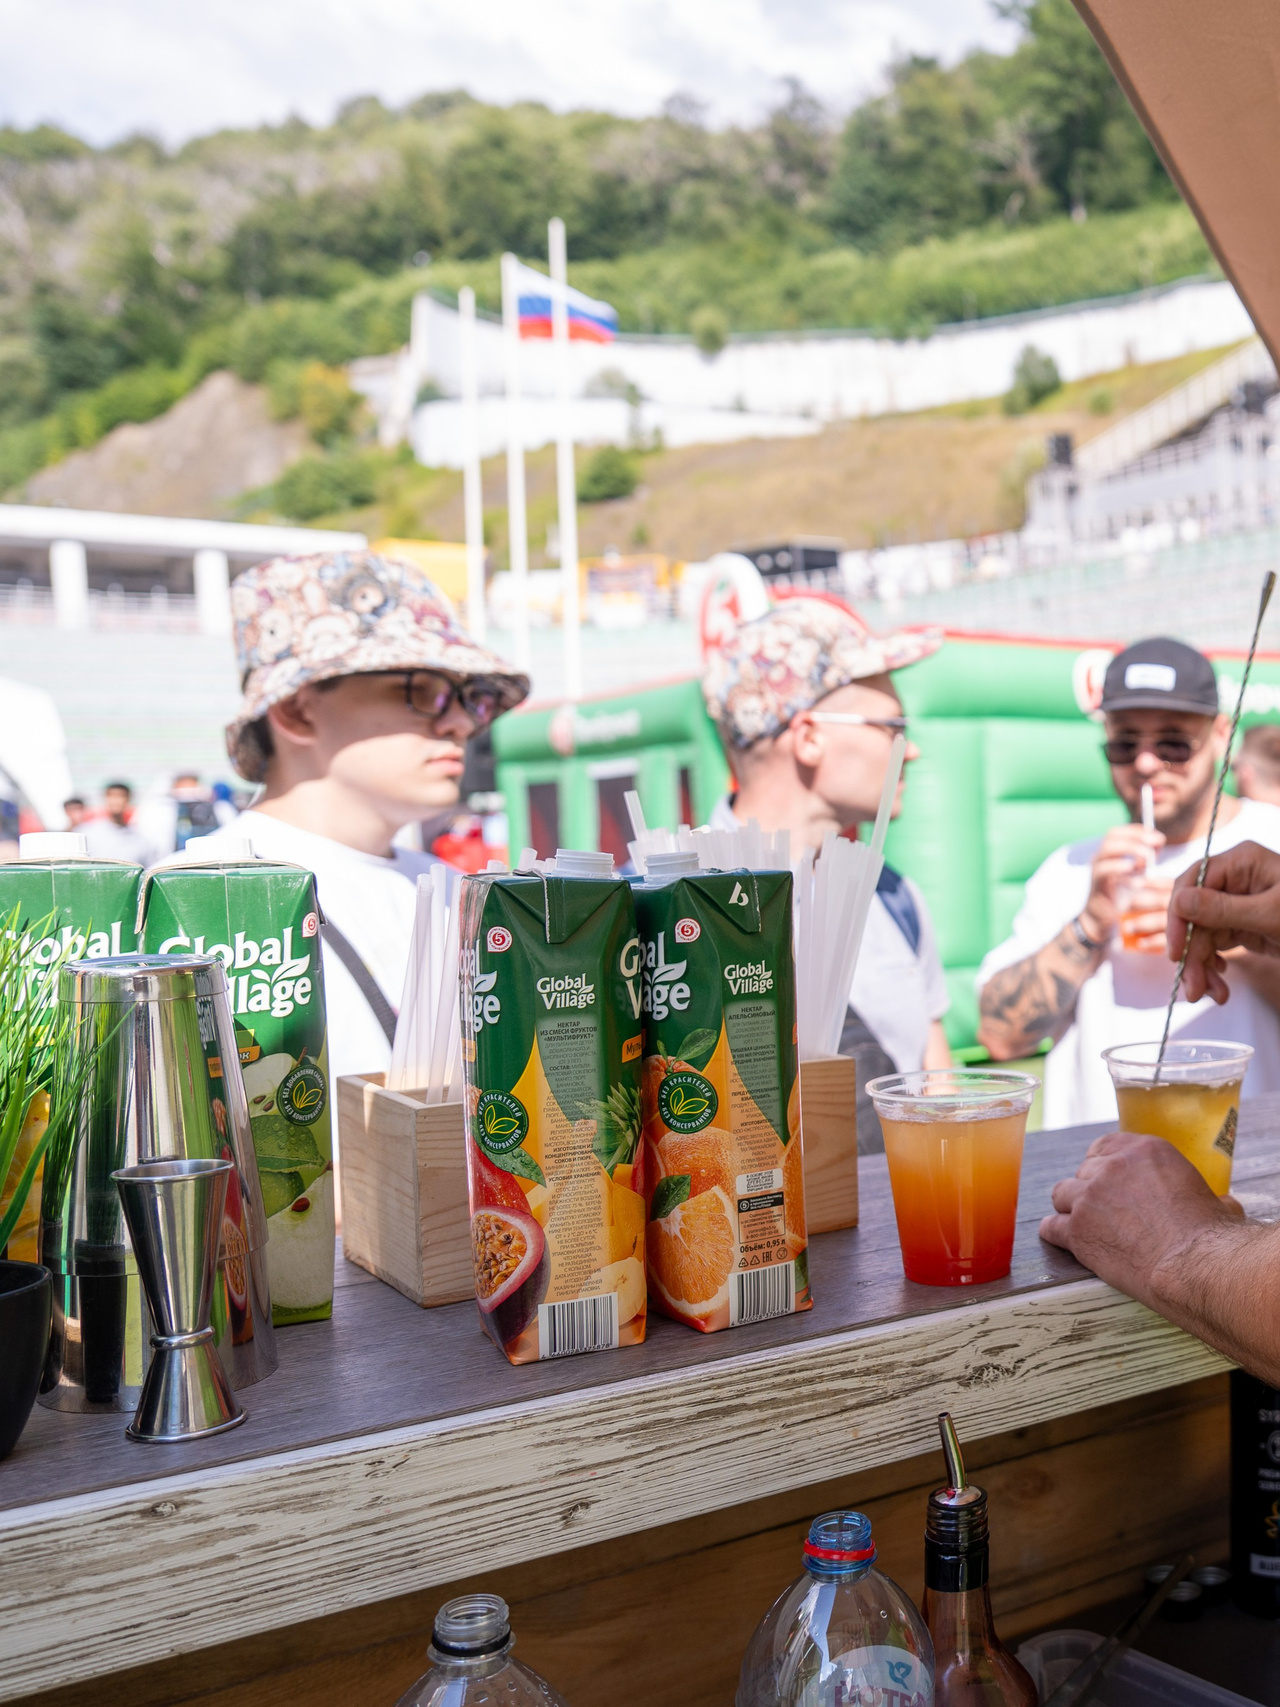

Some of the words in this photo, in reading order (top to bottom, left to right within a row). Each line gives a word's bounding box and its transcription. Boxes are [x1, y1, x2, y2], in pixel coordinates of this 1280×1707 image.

[5, 921, 138, 966] lobal
[724, 960, 767, 980] Global
[536, 973, 588, 993] Global
[728, 977, 774, 996] Village
[228, 973, 312, 1018] llage
[541, 991, 596, 1009] Village
[729, 1011, 776, 1020] АПЕЛЬСИНОВЫЙ
[544, 1033, 594, 1041] «МУЛЬТИФРУКТ»
[570, 1026, 598, 1034] ФРУКТОВ
[661, 1086, 670, 1099] БЕЗ
[669, 1077, 712, 1097] КРАСИТЕЛЕЙ
[484, 1094, 522, 1117] КРАСИТЕЛЕЙ
[662, 1107, 670, 1119] БЕЗ
[669, 1108, 712, 1129] КОНСЕРВАНТОВ
[484, 1129, 522, 1149] КОНСЕРВАНТОВ
